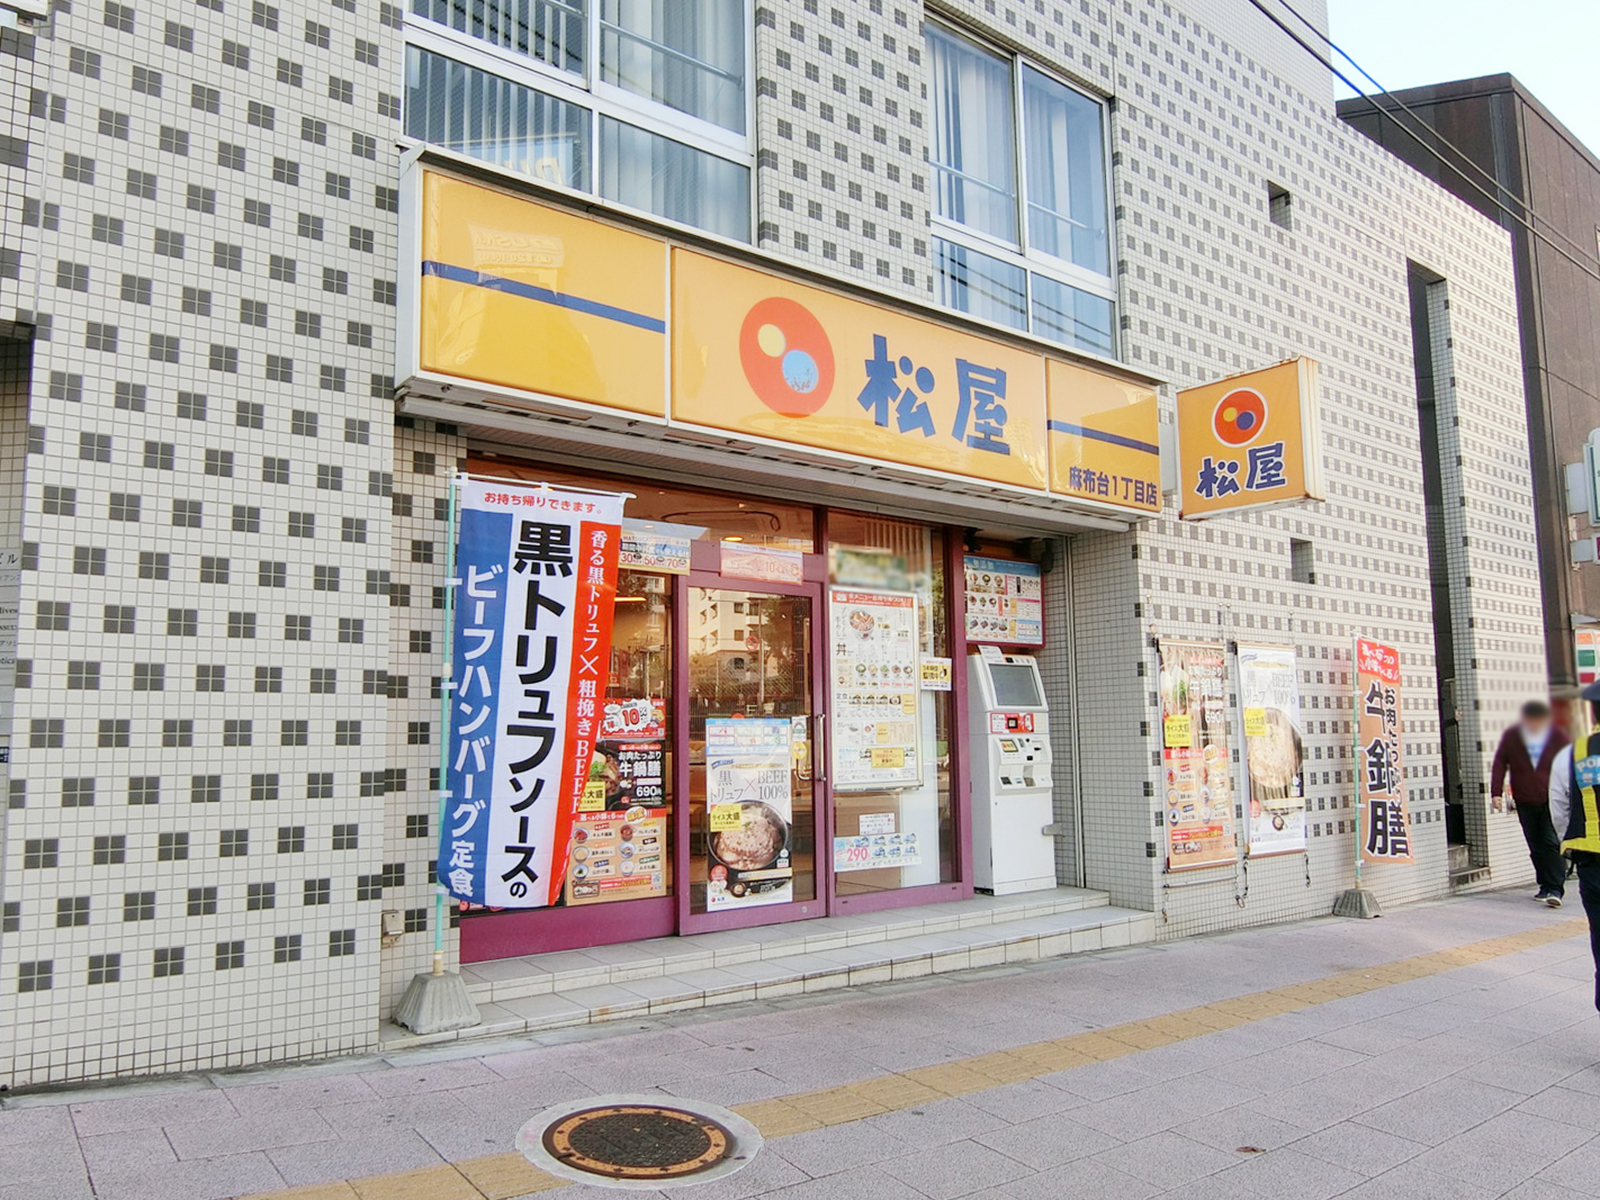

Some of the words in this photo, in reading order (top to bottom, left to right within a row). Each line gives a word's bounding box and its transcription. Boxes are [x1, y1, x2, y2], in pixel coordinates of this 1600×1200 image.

[857, 334, 1011, 455] 松屋
[1195, 441, 1286, 499] 松屋
[1068, 466, 1158, 506] 麻布台1丁目店
[484, 492, 602, 514] お持ち帰りできます。
[501, 520, 573, 898] 黒トリュフソースの
[448, 564, 504, 897] ビーフハンバーグ定食
[619, 761, 662, 778] 牛鍋膳
[717, 770, 733, 787] 黒
[757, 770, 788, 784] BEEF
[710, 788, 744, 803] トリュフ
[758, 785, 789, 800] 100%
